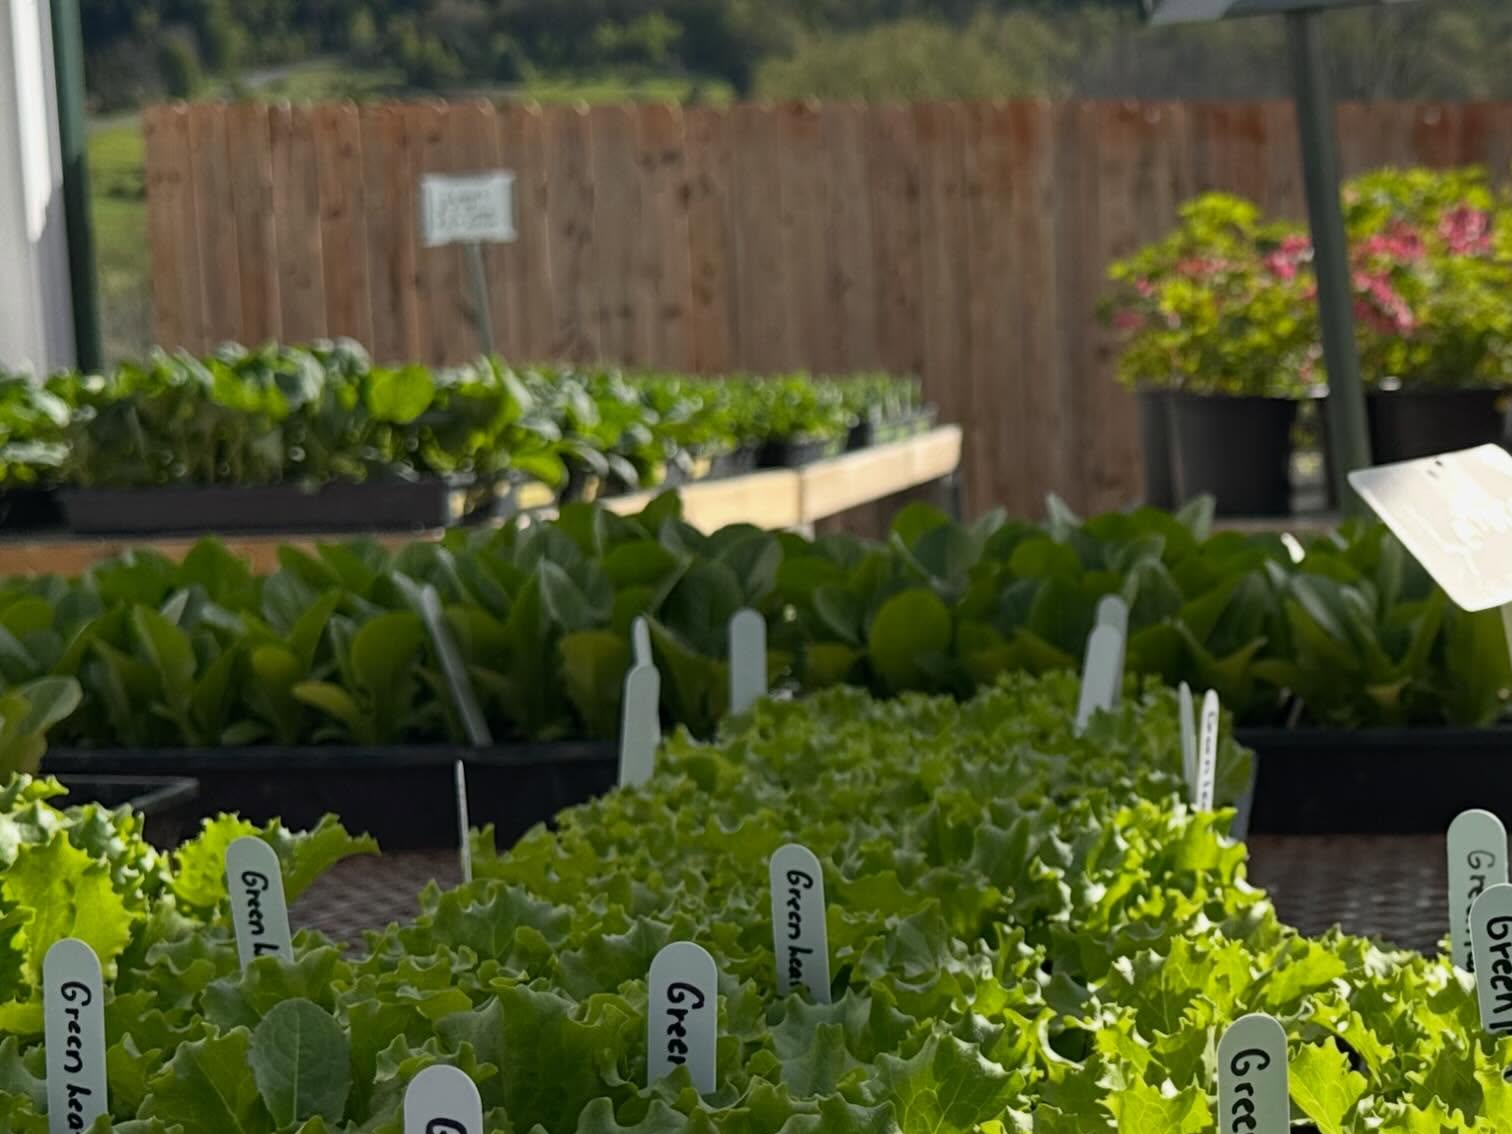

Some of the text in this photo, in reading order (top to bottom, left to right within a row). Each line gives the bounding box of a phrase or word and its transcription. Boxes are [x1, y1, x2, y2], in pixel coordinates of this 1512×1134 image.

[241, 870, 270, 936] Green
[786, 869, 814, 941] Green
[60, 981, 92, 1074] Green
